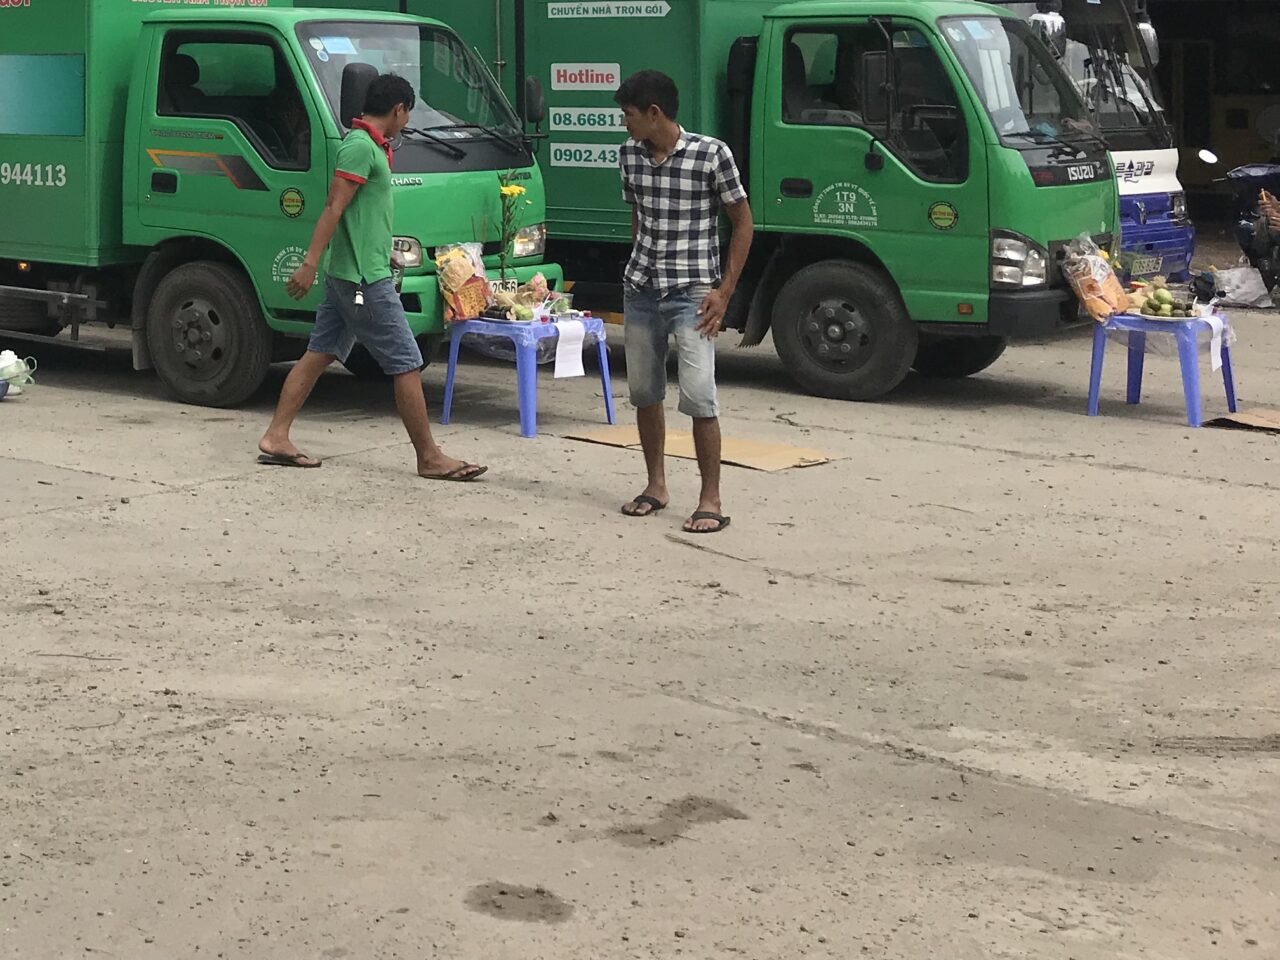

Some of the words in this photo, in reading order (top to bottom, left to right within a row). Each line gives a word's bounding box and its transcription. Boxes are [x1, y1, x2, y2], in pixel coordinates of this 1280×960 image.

[592, 4, 612, 14] NHÀ
[615, 6, 642, 15] TRỌN
[556, 69, 614, 84] Hotline
[1067, 165, 1094, 180] ISUZU
[835, 192, 856, 202] 1T9
[838, 203, 854, 213] 3N
